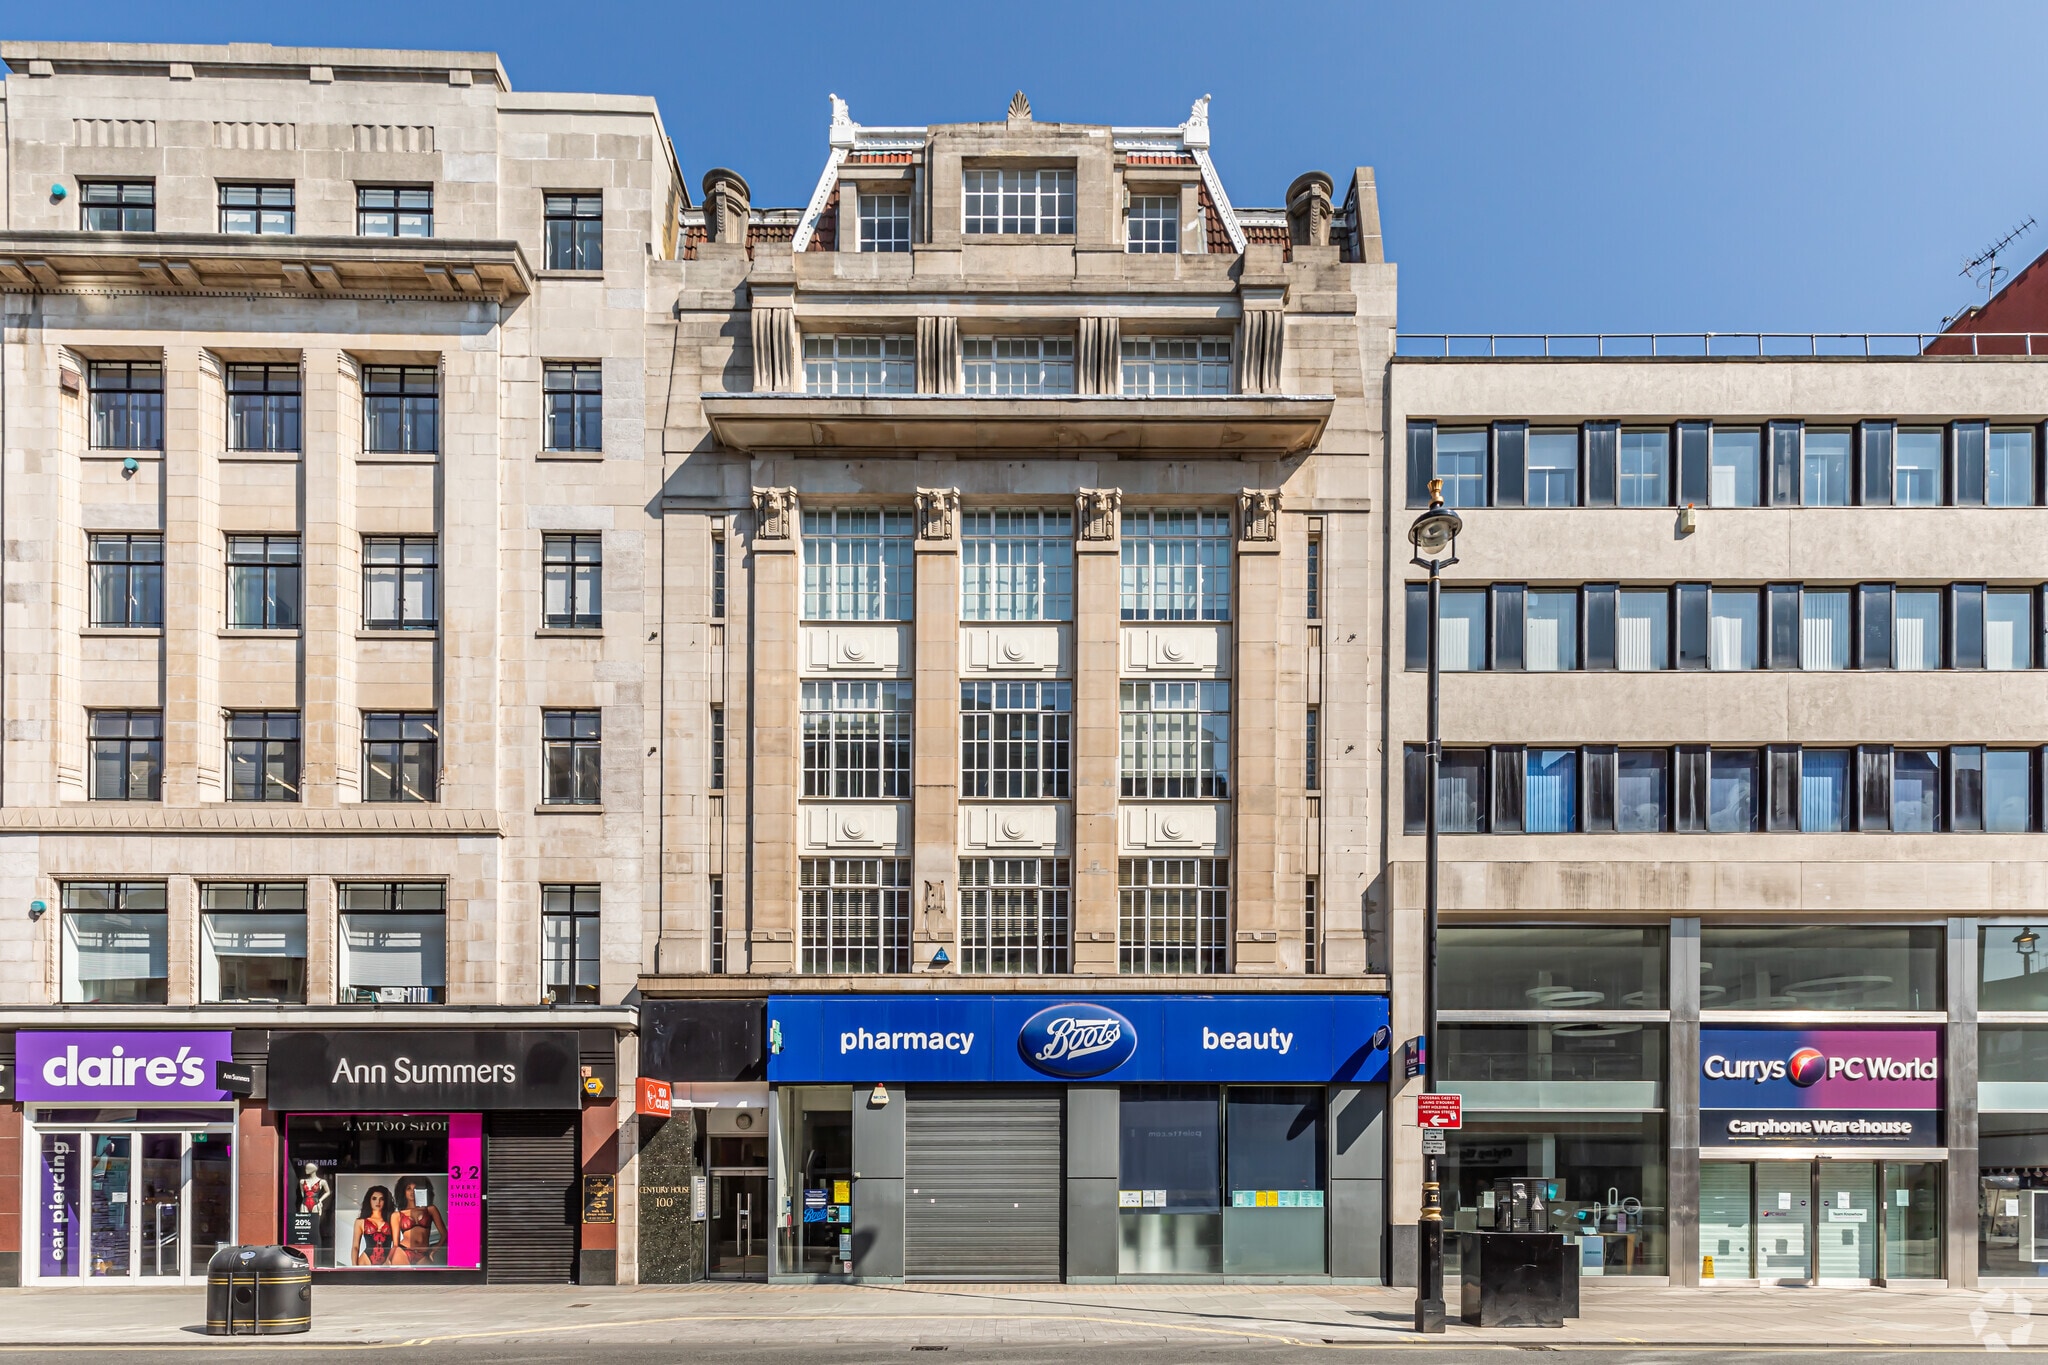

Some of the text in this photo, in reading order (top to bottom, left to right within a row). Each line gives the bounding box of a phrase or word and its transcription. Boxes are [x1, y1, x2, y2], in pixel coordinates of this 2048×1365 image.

[841, 1027, 974, 1054] pharmacy
[1035, 1018, 1121, 1061] Boots
[1203, 1026, 1293, 1054] beauty
[43, 1045, 205, 1087] claire's
[332, 1057, 516, 1083] Ann Summers
[1704, 1055, 1938, 1083] Currys PC World
[223, 1072, 250, 1083] Ann Summers
[658, 1087, 667, 1098] 100
[655, 1099, 670, 1110] CLUB
[343, 1121, 406, 1131] TATTOO
[1728, 1119, 1912, 1136] Carphone Warehouse
[451, 1166, 479, 1179] 3 2
[639, 1186, 668, 1194] CENTURY
[49, 1142, 69, 1260] ear piercing
[656, 1197, 673, 1207] 100
